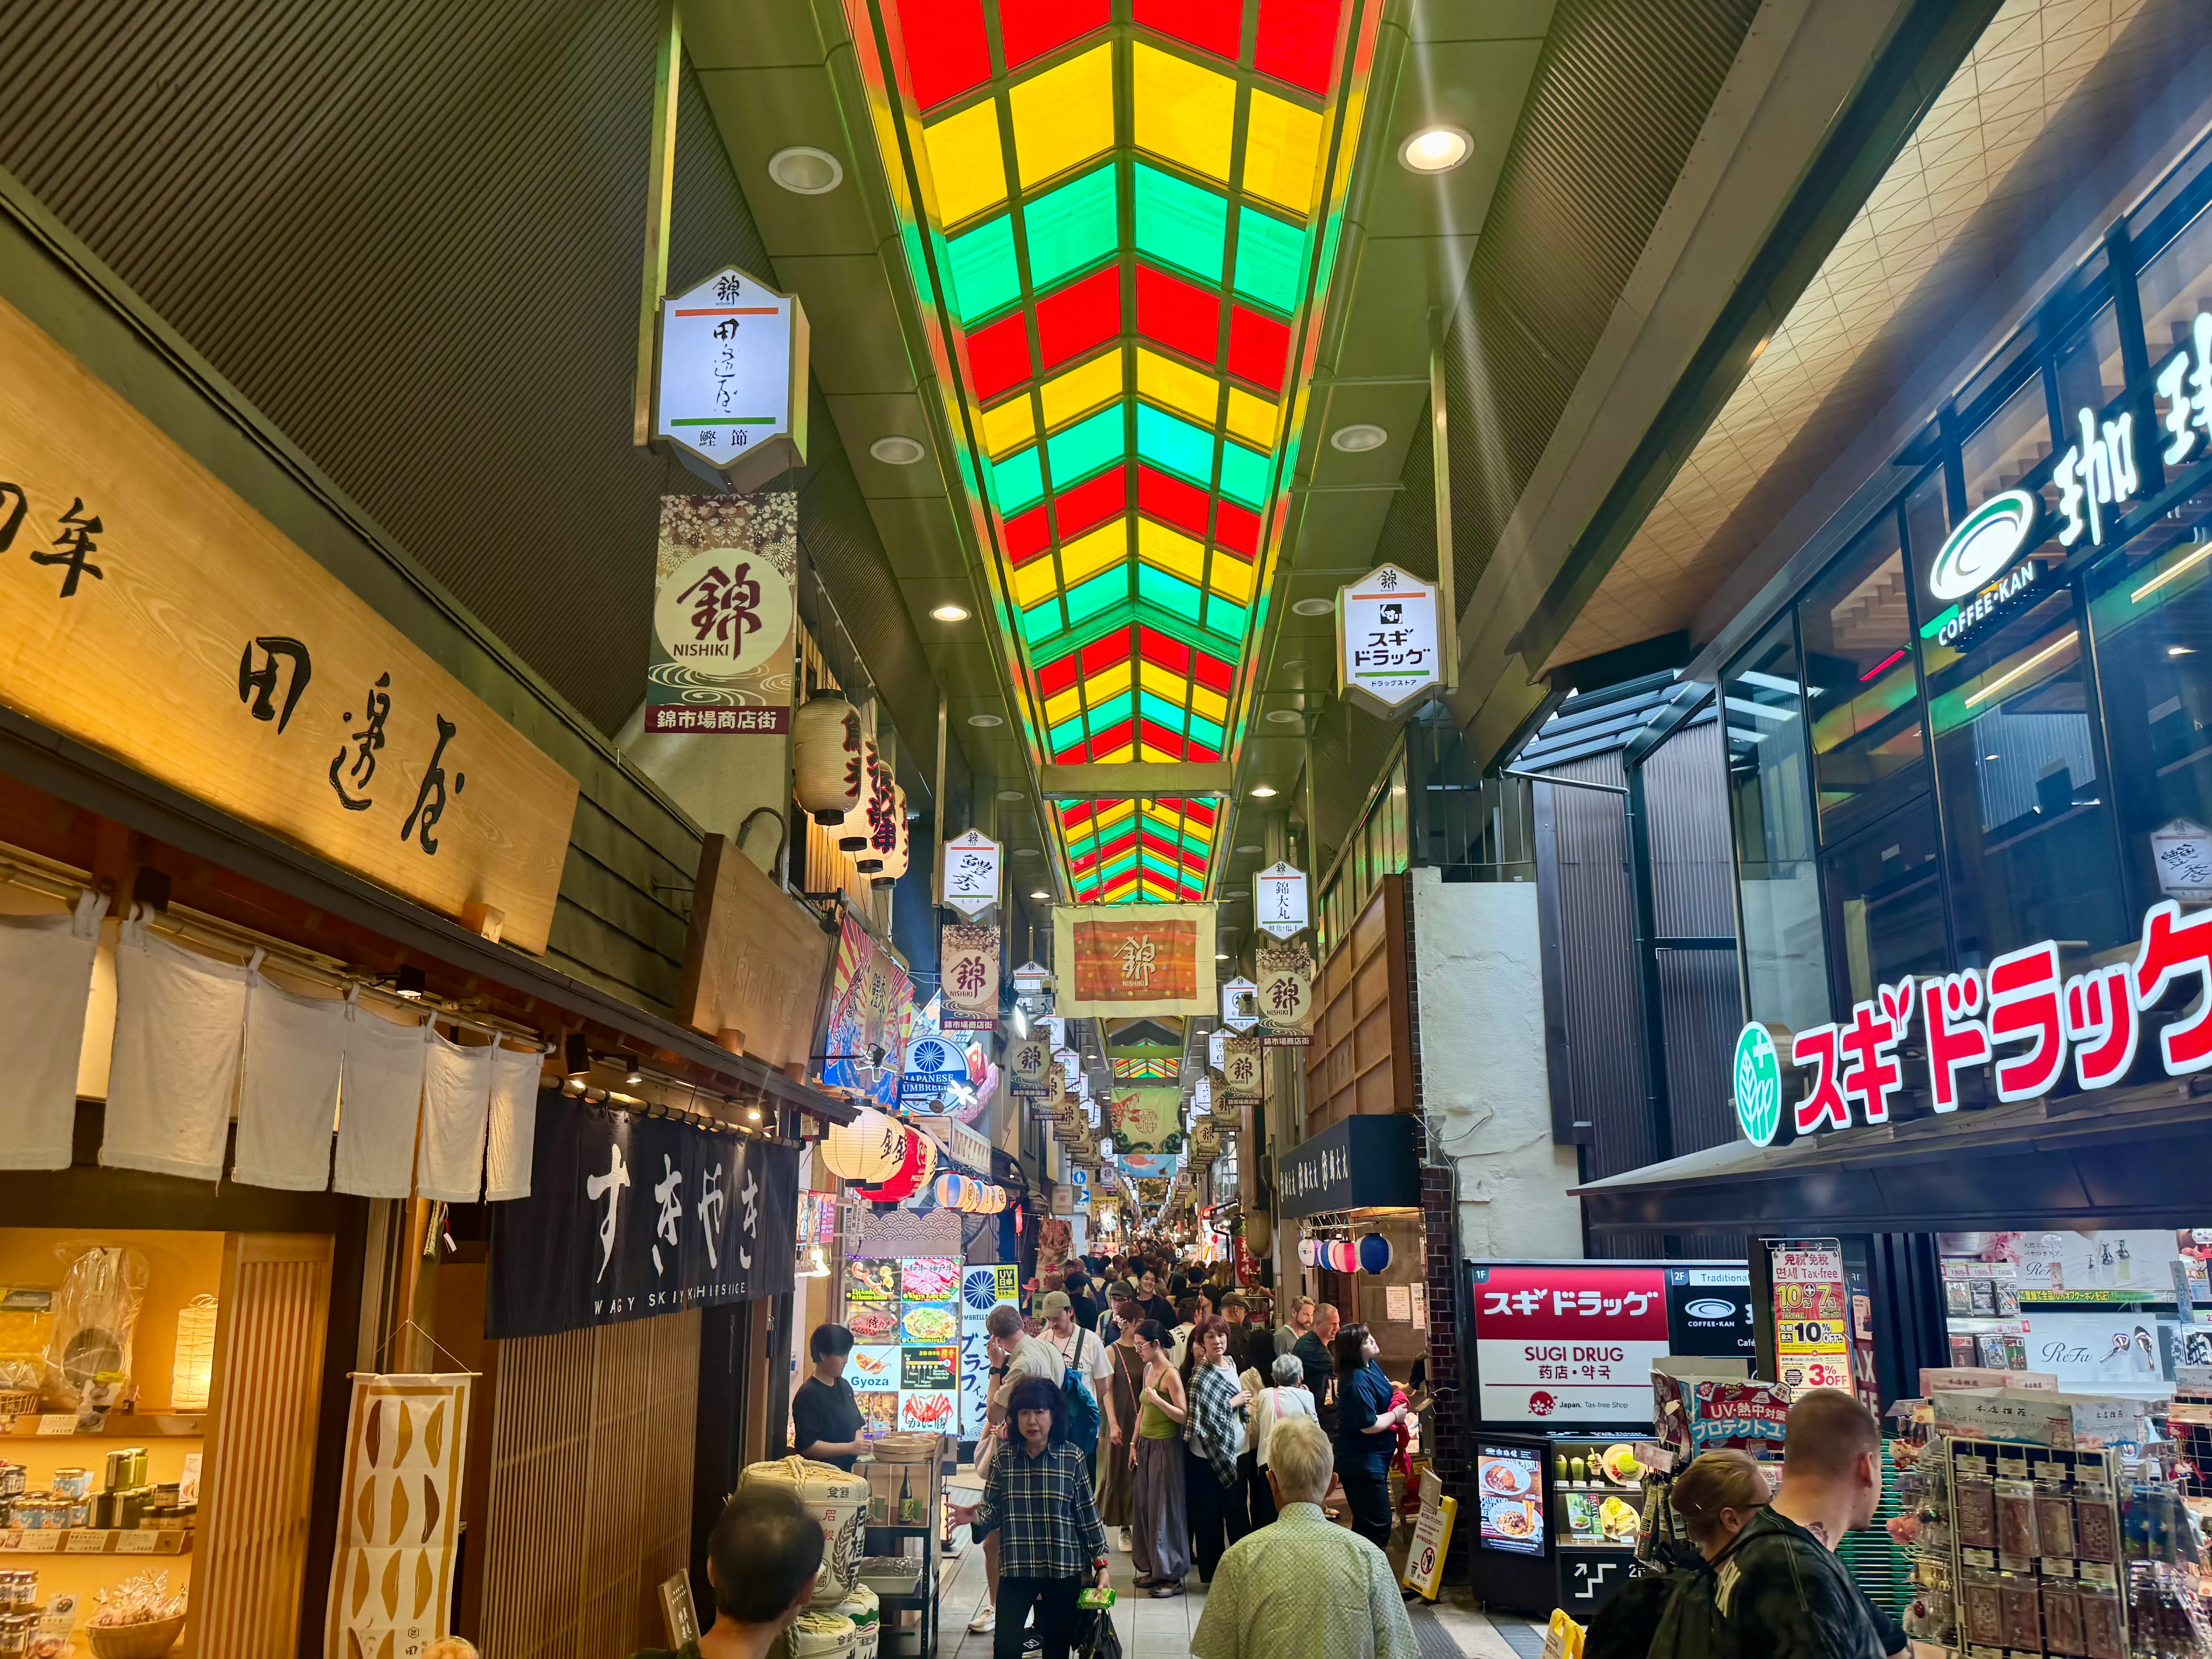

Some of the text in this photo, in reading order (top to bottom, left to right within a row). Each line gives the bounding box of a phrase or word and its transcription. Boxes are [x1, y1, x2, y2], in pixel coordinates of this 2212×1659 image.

[713, 275, 740, 305] 錦
[1377, 570, 1397, 591] 錦
[676, 562, 762, 660] 錦
[1368, 629, 1414, 647] スギ
[673, 643, 729, 657] NISHIKI
[1355, 648, 1431, 666] ドラッグ
[657, 709, 777, 730] 錦市場商店街
[966, 832, 978, 846] 錦
[1274, 862, 1285, 875] 錦
[1275, 881, 1290, 920] 錦大丸
[1113, 934, 1156, 987] 錦
[951, 956, 986, 999] 錦
[1266, 977, 1300, 1017] 錦
[943, 1020, 992, 1030] 錦市場商店街
[1263, 1037, 1309, 1046] 錦市場商店街
[1017, 1046, 1042, 1075] 錦
[905, 1073, 954, 1083] JAPANESE
[1230, 1057, 1253, 1085] 錦
[902, 1084, 947, 1092] UMBREL
[587, 1143, 758, 1283] すきやき
[908, 1264, 954, 1273] 和牛 神戸牛
[999, 1270, 1013, 1279] UV
[1476, 1270, 1485, 1279] 1F
[1675, 1272, 1684, 1280] 2F
[1801, 1267, 1838, 1279] Tax-free
[907, 1292, 925, 1301] Wagyu
[595, 1297, 635, 1315] WAGY
[1525, 1347, 1623, 1362] SUGI DRUG
[2041, 1342, 2092, 1363] ReFa
[1854, 1349, 1877, 1384] AX
[851, 1376, 889, 1388] Gyoza
[1825, 1375, 1848, 1386] OFF
